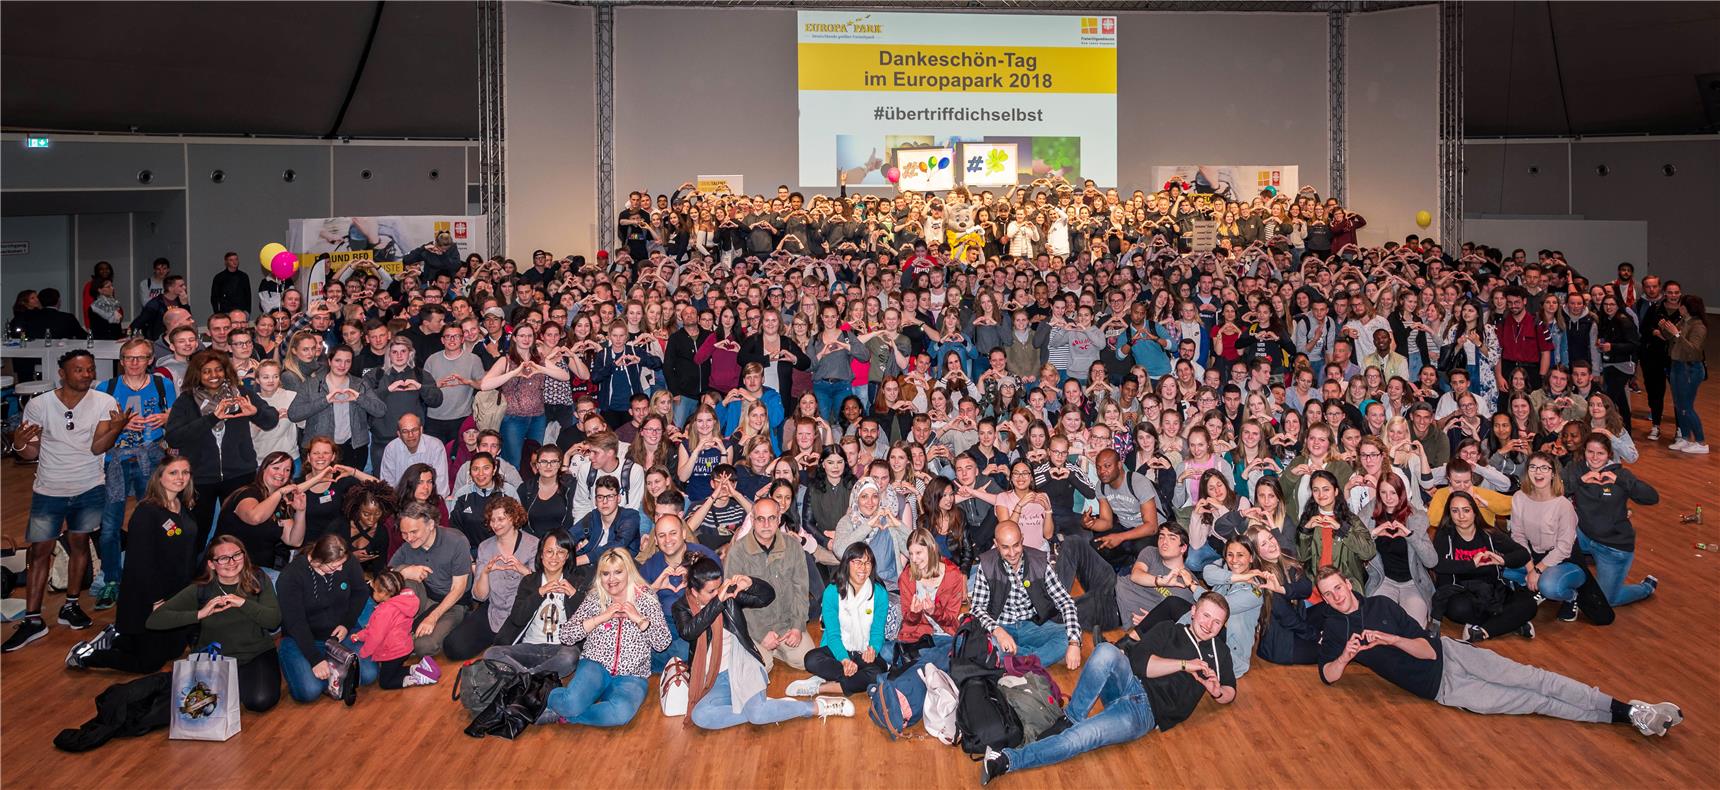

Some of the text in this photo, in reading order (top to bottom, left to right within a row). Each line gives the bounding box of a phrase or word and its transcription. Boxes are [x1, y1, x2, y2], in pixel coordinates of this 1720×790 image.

[805, 23, 883, 33] EUROPA PARK
[879, 50, 1037, 71] Dankeschön-Tag
[864, 71, 1053, 91] im Europapark 2018
[873, 106, 1043, 122] #übertriffdichselbst
[331, 254, 350, 263] UND
